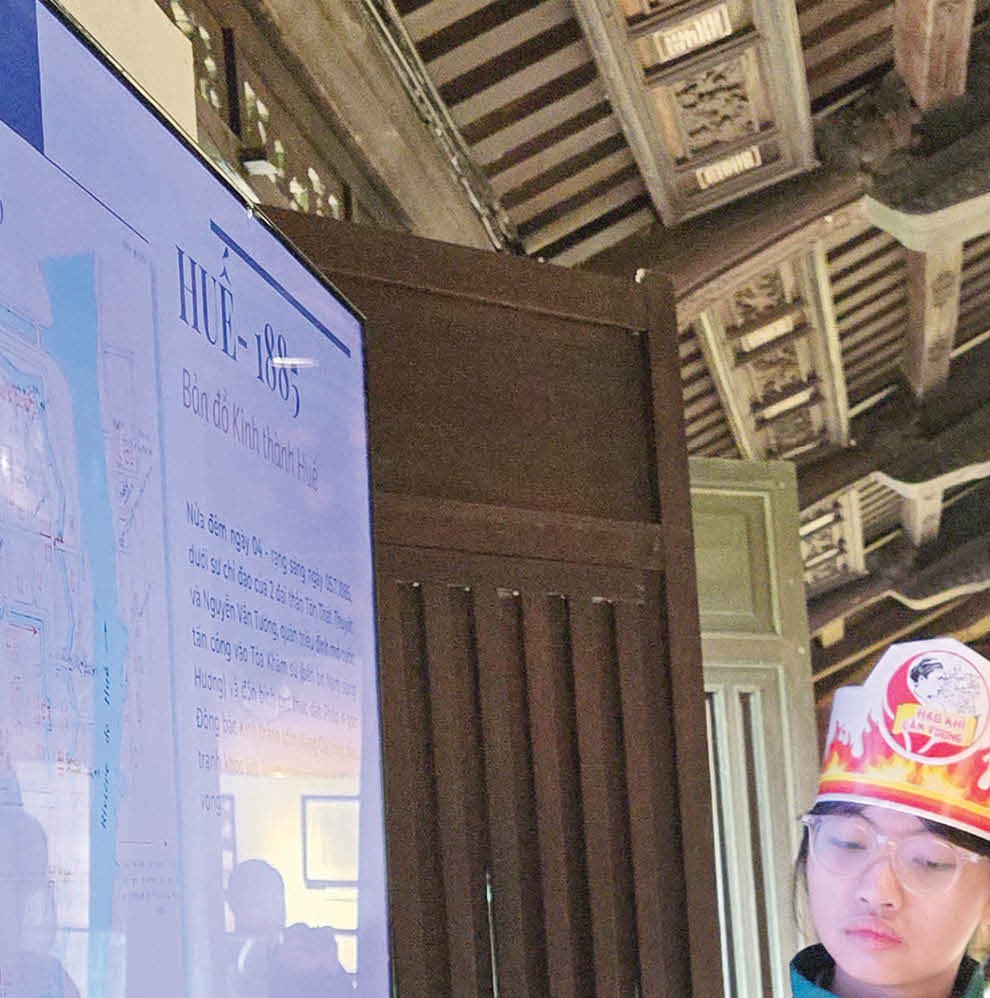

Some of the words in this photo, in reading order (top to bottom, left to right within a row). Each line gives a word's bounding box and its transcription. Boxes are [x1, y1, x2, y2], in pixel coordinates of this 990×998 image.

[255, 323, 300, 418] 1885
[182, 367, 209, 422] Bản
[212, 387, 229, 434] đồ
[232, 402, 260, 455] Kinh
[262, 425, 296, 477] thành
[252, 535, 263, 558] 04
